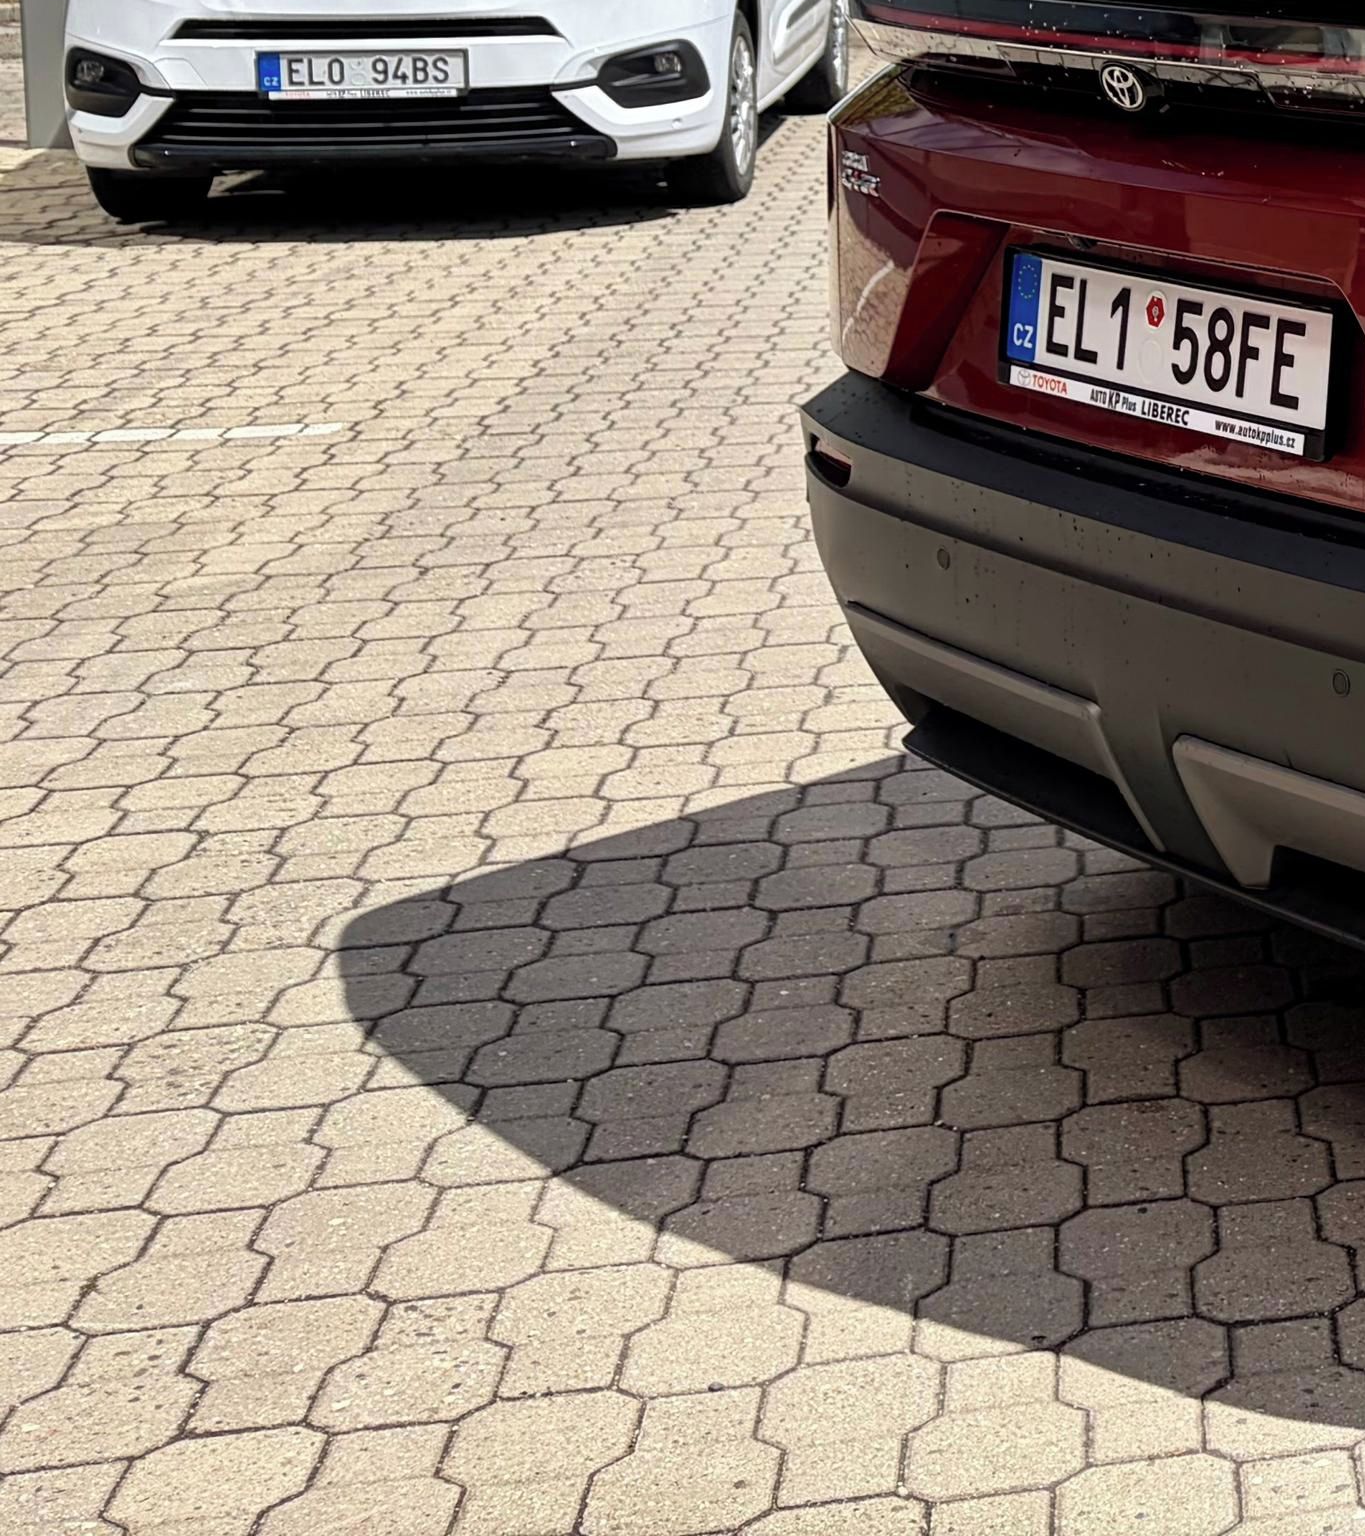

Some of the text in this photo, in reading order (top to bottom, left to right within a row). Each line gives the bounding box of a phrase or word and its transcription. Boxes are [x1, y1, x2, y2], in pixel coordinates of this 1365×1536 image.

[263, 77, 279, 86] CZ
[371, 56, 449, 85] 94BS
[1013, 323, 1033, 348] CZ
[1046, 273, 1307, 410] EL1 58FE
[1031, 374, 1068, 395] TOYOTA
[1090, 388, 1190, 426] AUTO KP Plus LIBEREC
[1215, 419, 1296, 448] www.autokpplus.cz
